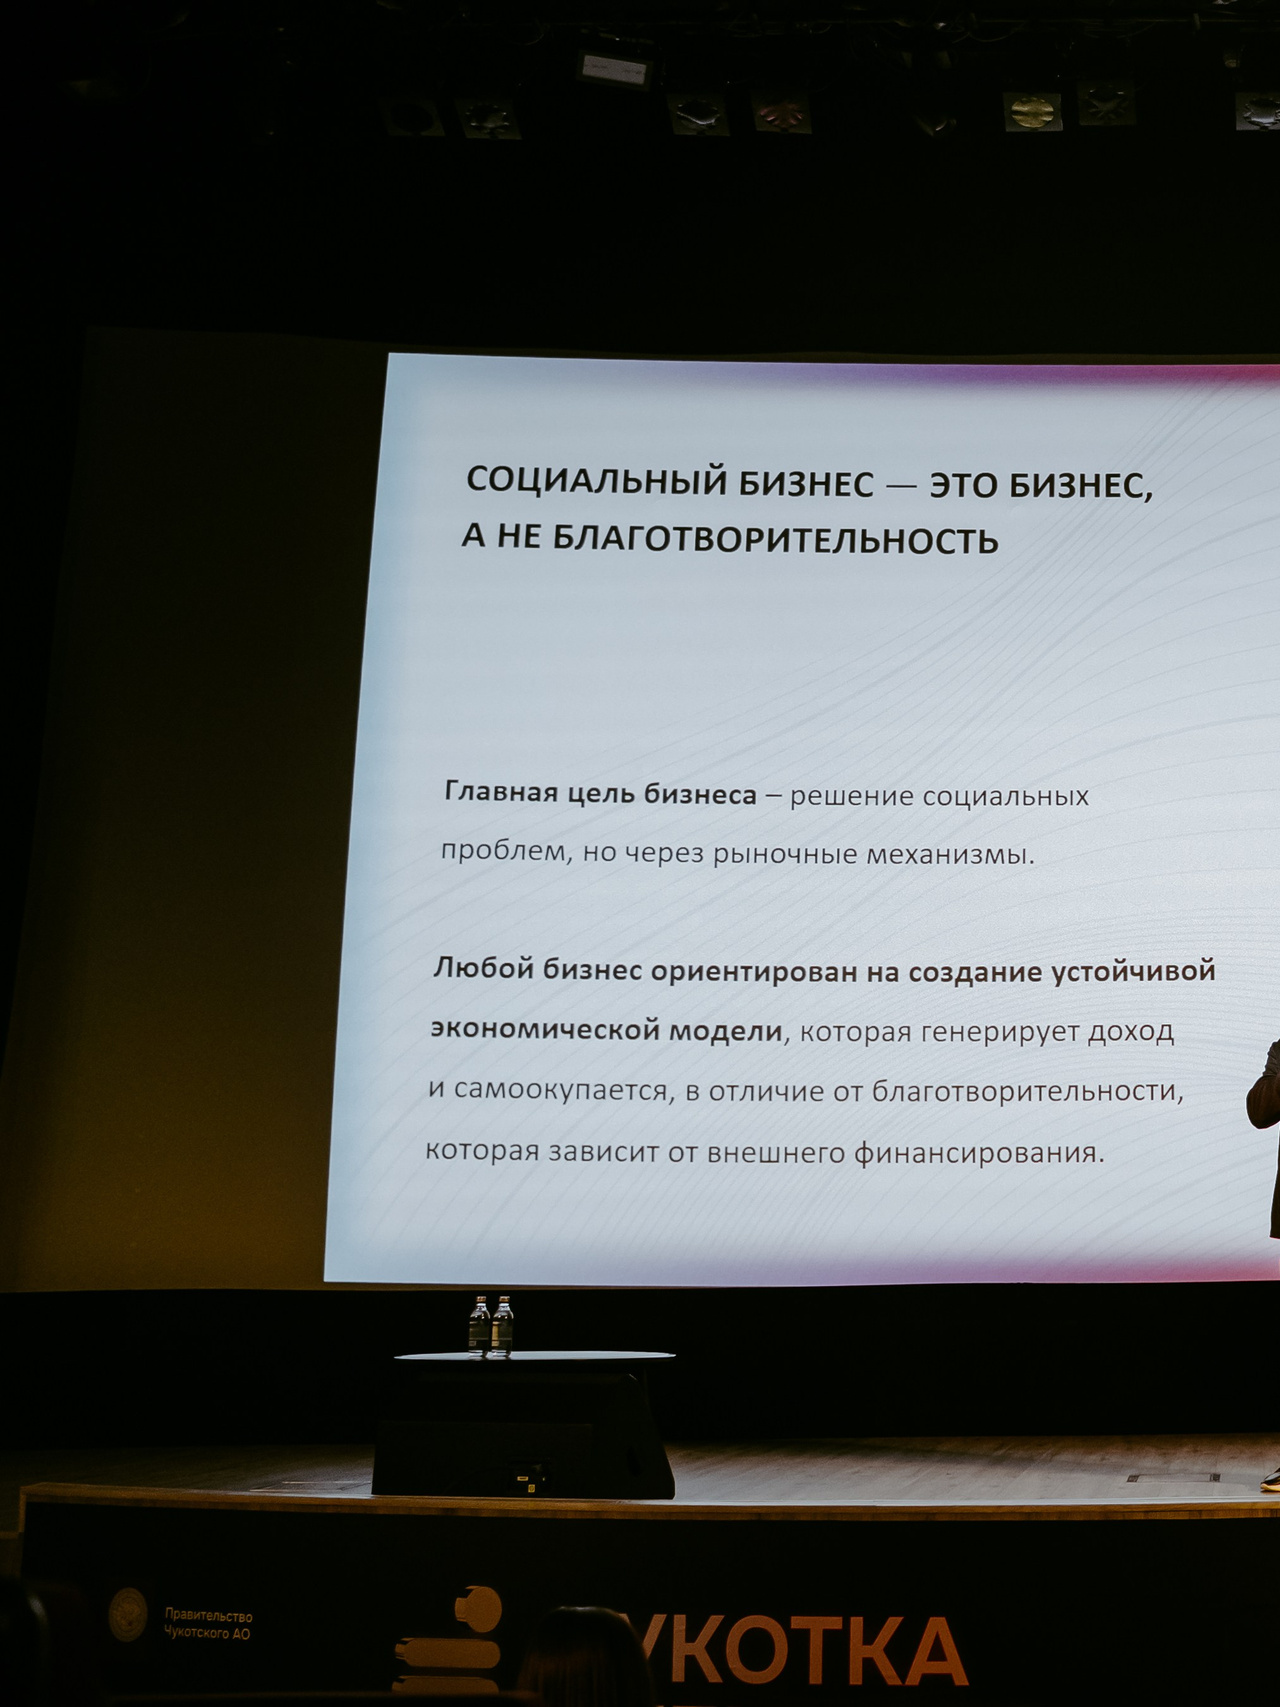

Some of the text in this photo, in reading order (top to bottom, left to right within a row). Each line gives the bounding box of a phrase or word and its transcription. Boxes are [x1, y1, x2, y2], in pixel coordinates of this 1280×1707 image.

[466, 461, 728, 499] СОЦИАЛЬНЫЙ
[739, 470, 875, 498] БИЗНЕС
[930, 471, 999, 499] ЭТО
[1010, 472, 1153, 504] БИЗНЕС,
[460, 521, 999, 555] А НЕ БЛАГОТВОРИТЕЛЬНОСТЬ
[445, 778, 559, 803] Главная
[568, 786, 636, 809] цель
[644, 781, 757, 806] бизнеса
[790, 789, 914, 811] решение
[923, 789, 1090, 812] социальных
[441, 837, 1035, 869] проблем, но через рыночные механизмы.
[432, 954, 1216, 988] Любой бизнес ориентирован на создание устойчивой
[430, 1016, 1175, 1048] экономической модели, которая генерирует доход
[428, 1078, 1184, 1108] и самоокупается, в отличие от благотворительности,
[426, 1139, 1105, 1170] которая зависит от внешнего финансирования.
[164, 1606, 253, 1623] Правительство
[164, 1624, 251, 1641] Чукотского АО
[618, 1613, 970, 1686] УКОТКА
